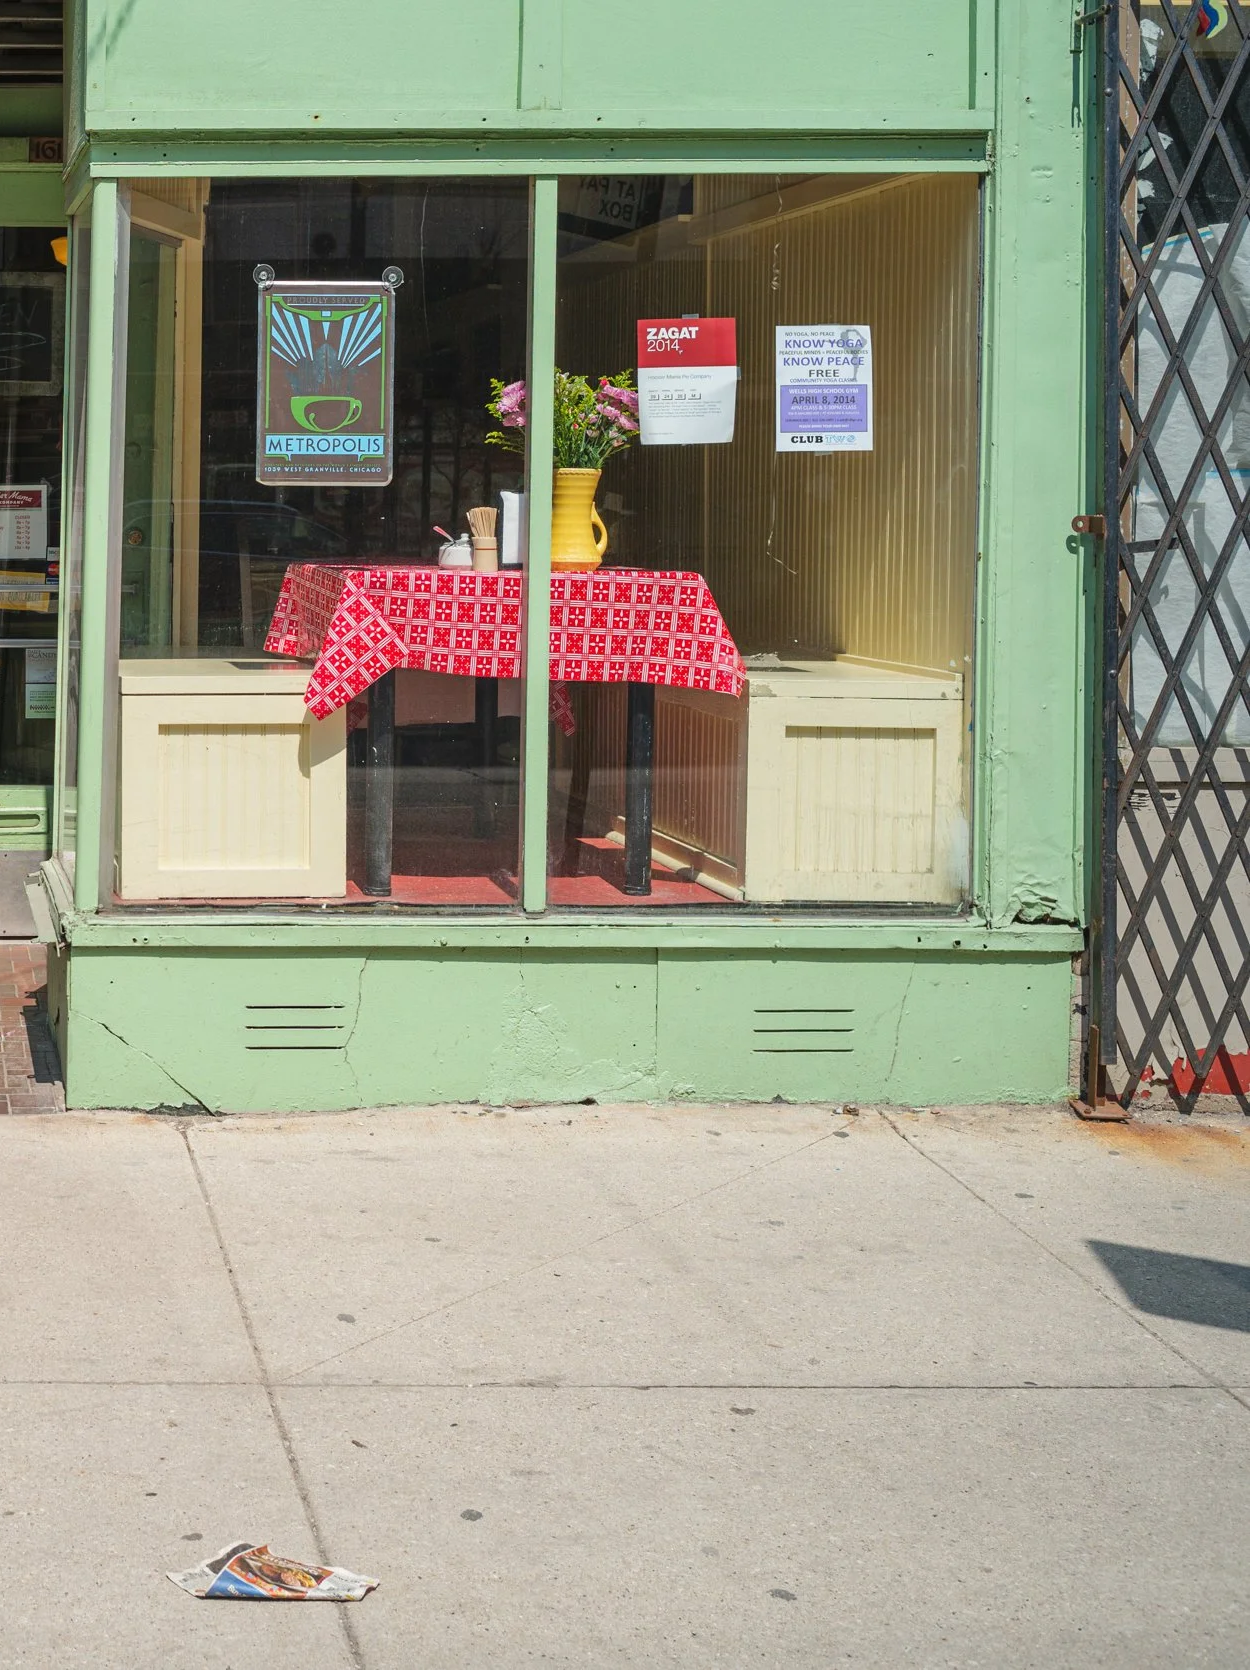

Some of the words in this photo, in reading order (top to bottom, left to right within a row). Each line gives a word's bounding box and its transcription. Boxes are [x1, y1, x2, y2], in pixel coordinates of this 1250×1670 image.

[36, 140, 63, 159] 161
[646, 327, 699, 340] ZAGAT
[647, 340, 680, 352] 2014
[785, 339, 825, 348] KNOW
[829, 339, 863, 348] YOGA
[783, 357, 824, 366] KNOW
[827, 356, 864, 366] PEACE
[809, 369, 840, 378] FREE
[792, 396, 820, 404] APRIL
[822, 396, 830, 405] 8,
[833, 396, 856, 404] 2014
[268, 438, 380, 452] METROPOLIS
[8, 491, 33, 502] Mama
